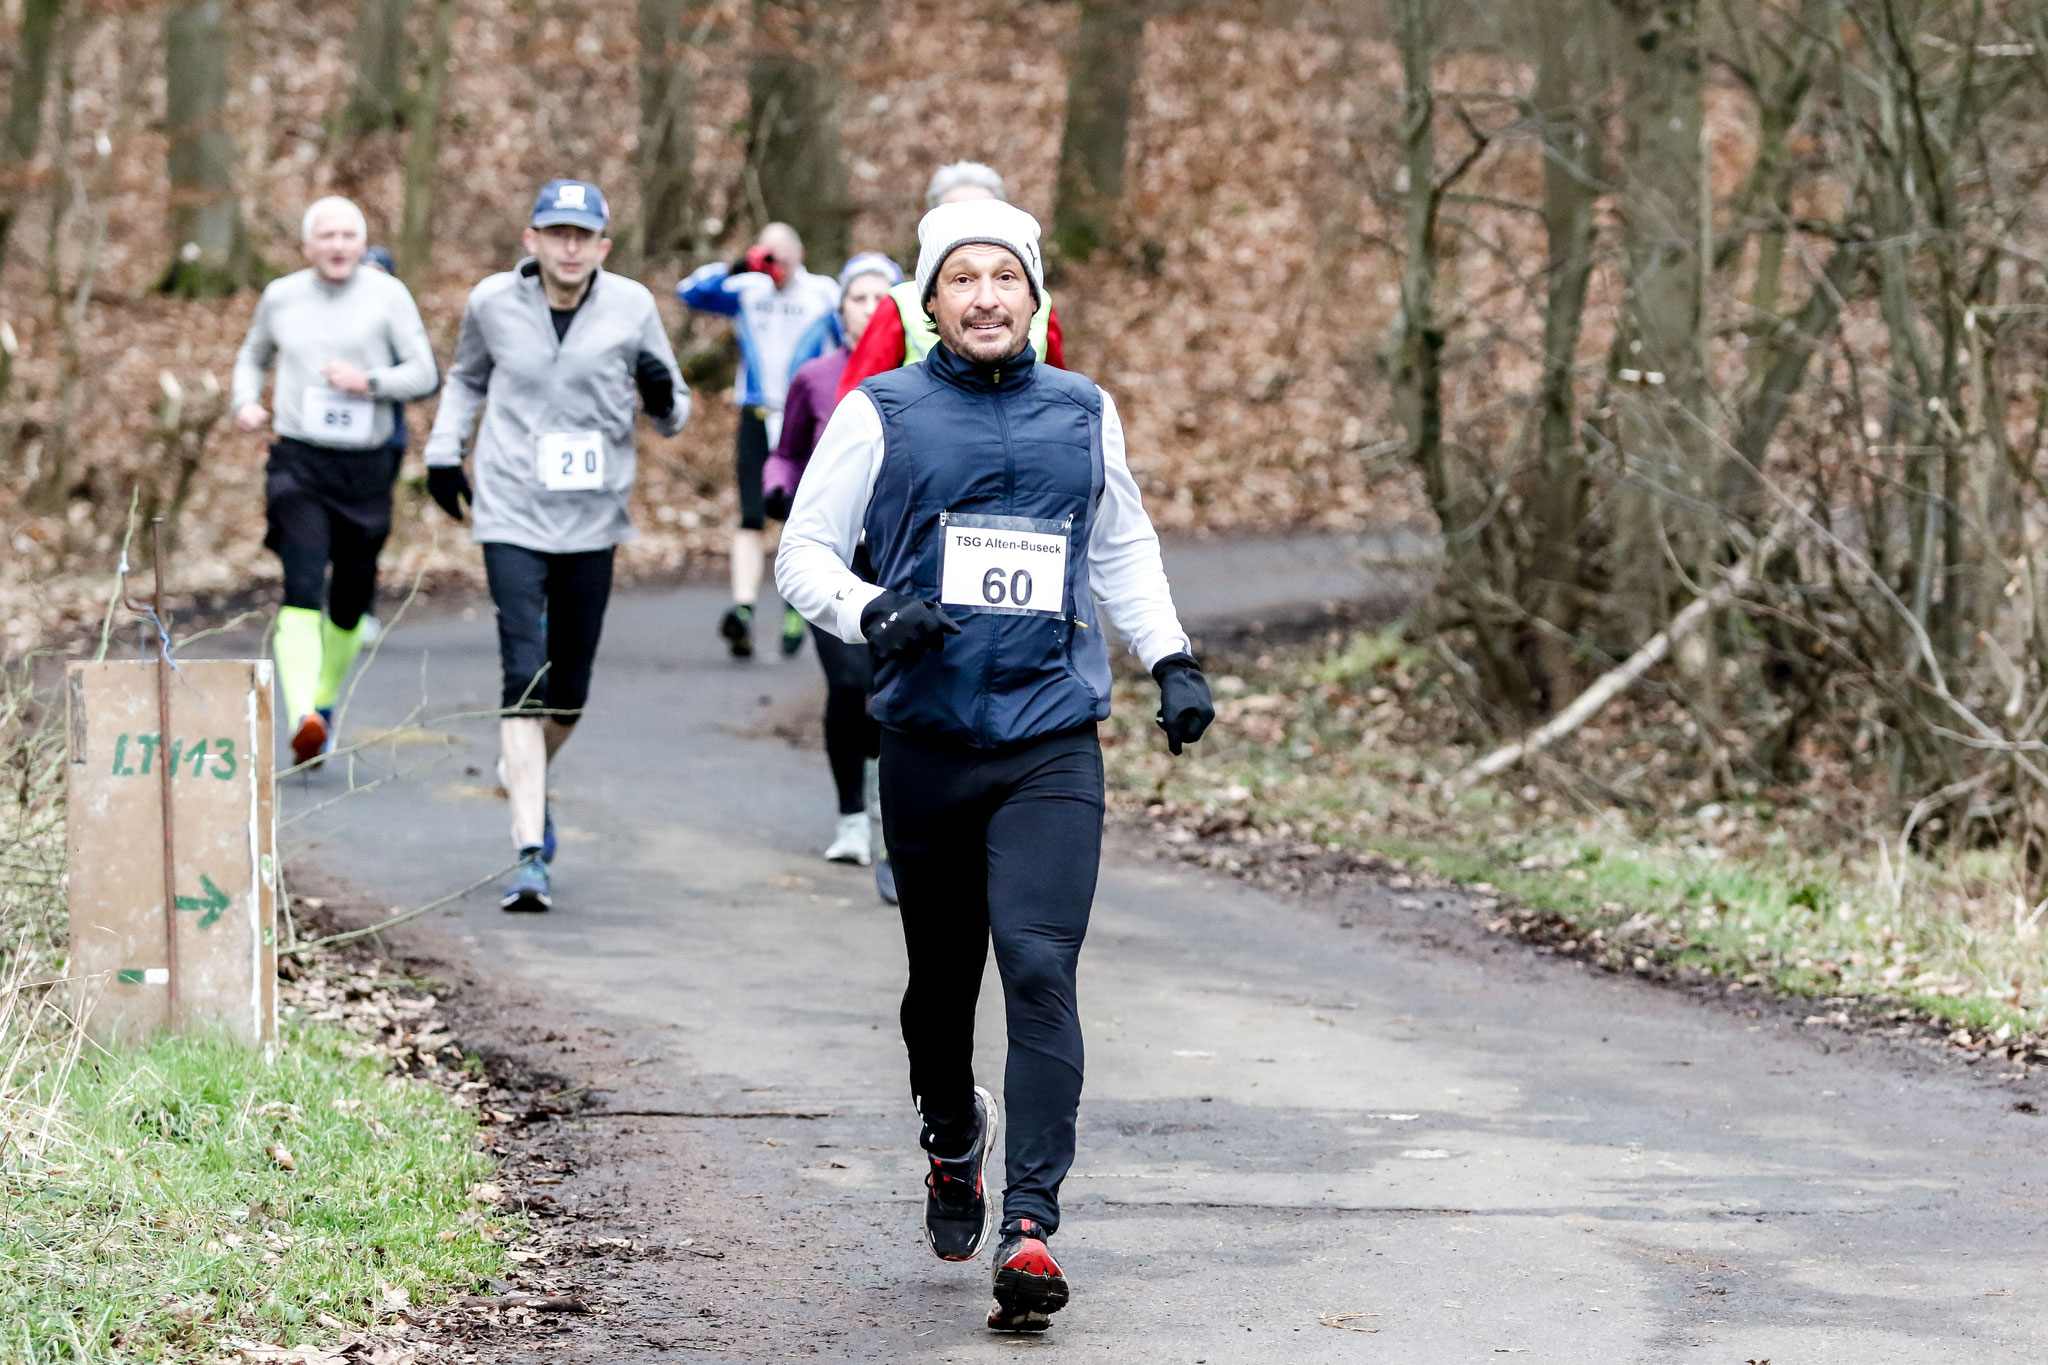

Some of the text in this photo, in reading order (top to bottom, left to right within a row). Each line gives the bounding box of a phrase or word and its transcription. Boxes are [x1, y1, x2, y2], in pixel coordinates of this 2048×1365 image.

[561, 450, 597, 475] 20
[956, 535, 1061, 554] TSG Alten-Buseck
[982, 567, 1033, 606] 60
